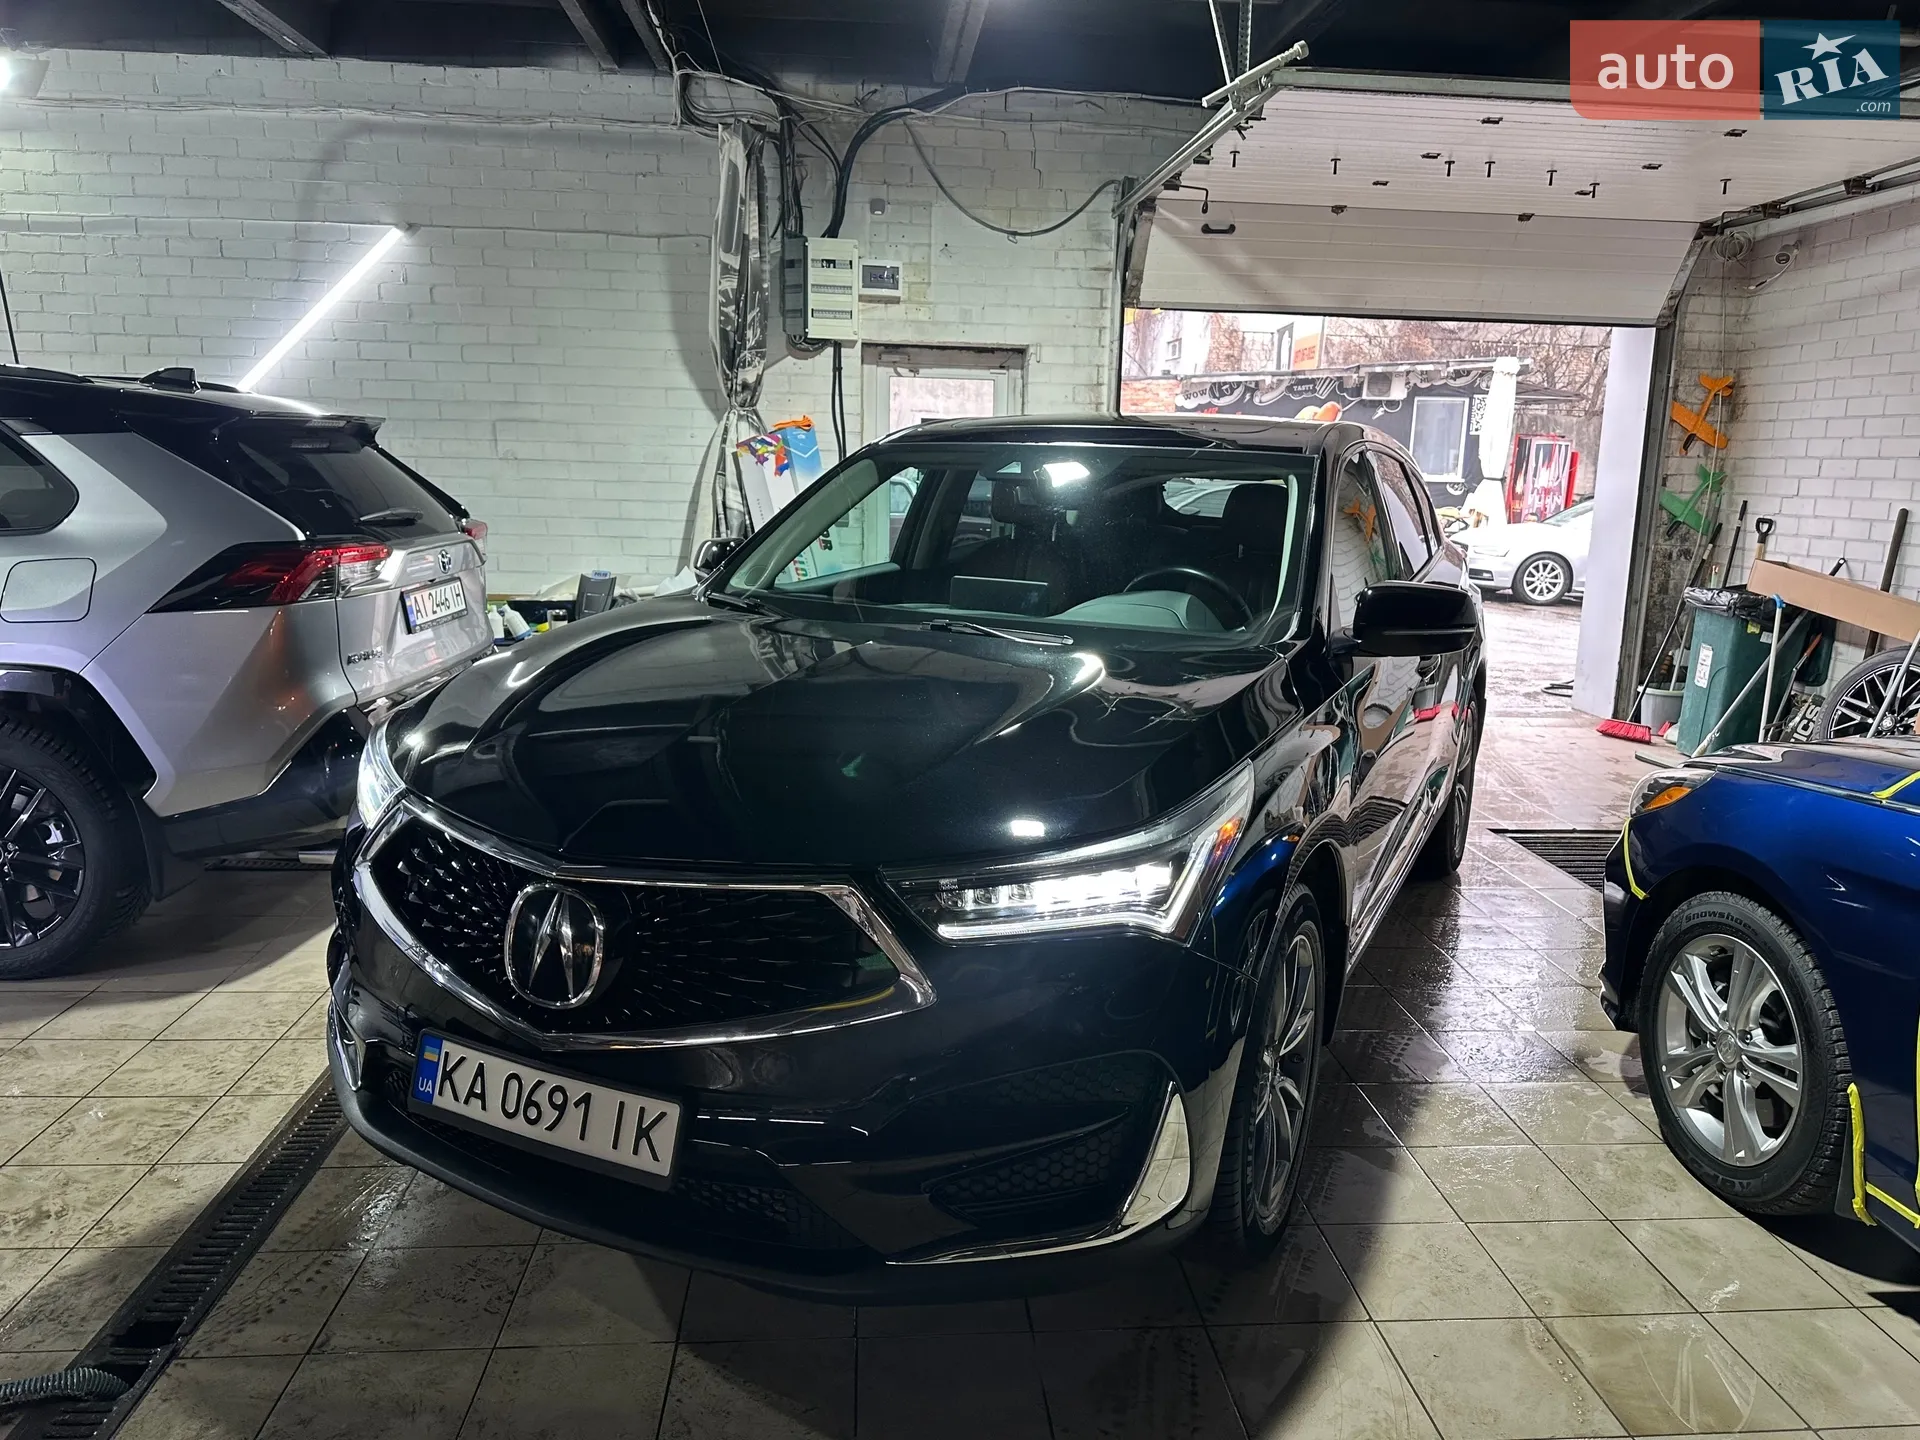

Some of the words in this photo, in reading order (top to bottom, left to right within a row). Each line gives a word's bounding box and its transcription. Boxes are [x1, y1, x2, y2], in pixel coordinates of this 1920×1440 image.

[1182, 387, 1208, 401] WOW
[413, 594, 429, 620] AI
[428, 587, 451, 615] 2446
[449, 584, 464, 608] IH
[1685, 910, 1758, 937] Snowshoes
[418, 1078, 433, 1094] UA
[437, 1050, 488, 1112] KA
[500, 1071, 593, 1142] 0691
[611, 1100, 668, 1163] IK
